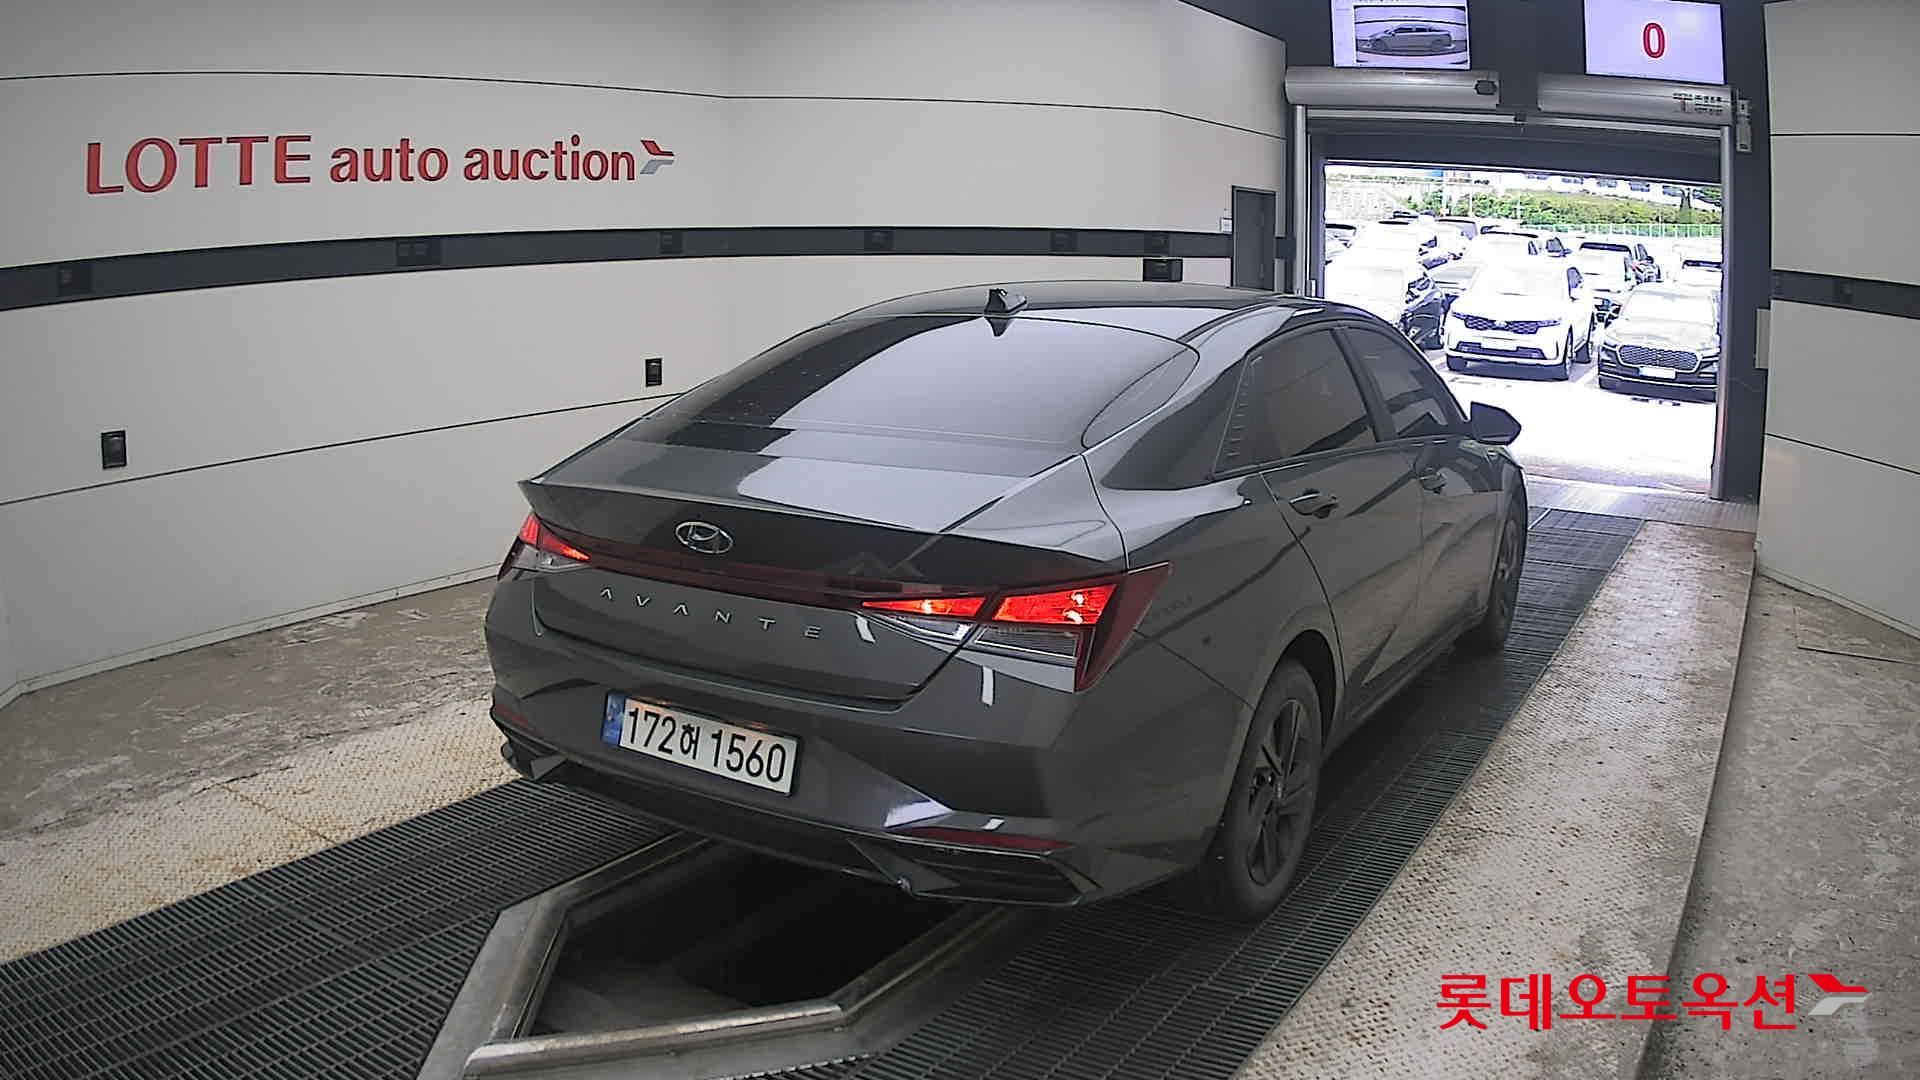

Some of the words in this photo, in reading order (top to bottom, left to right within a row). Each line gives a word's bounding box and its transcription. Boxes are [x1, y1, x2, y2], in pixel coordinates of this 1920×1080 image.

[1643, 22, 1665, 59] 0
[87, 135, 311, 194] LOTTE
[330, 138, 448, 182] auto
[464, 134, 635, 181] auction
[599, 588, 821, 639] AVANTE
[628, 707, 700, 760] 172허
[711, 729, 787, 783] 1560
